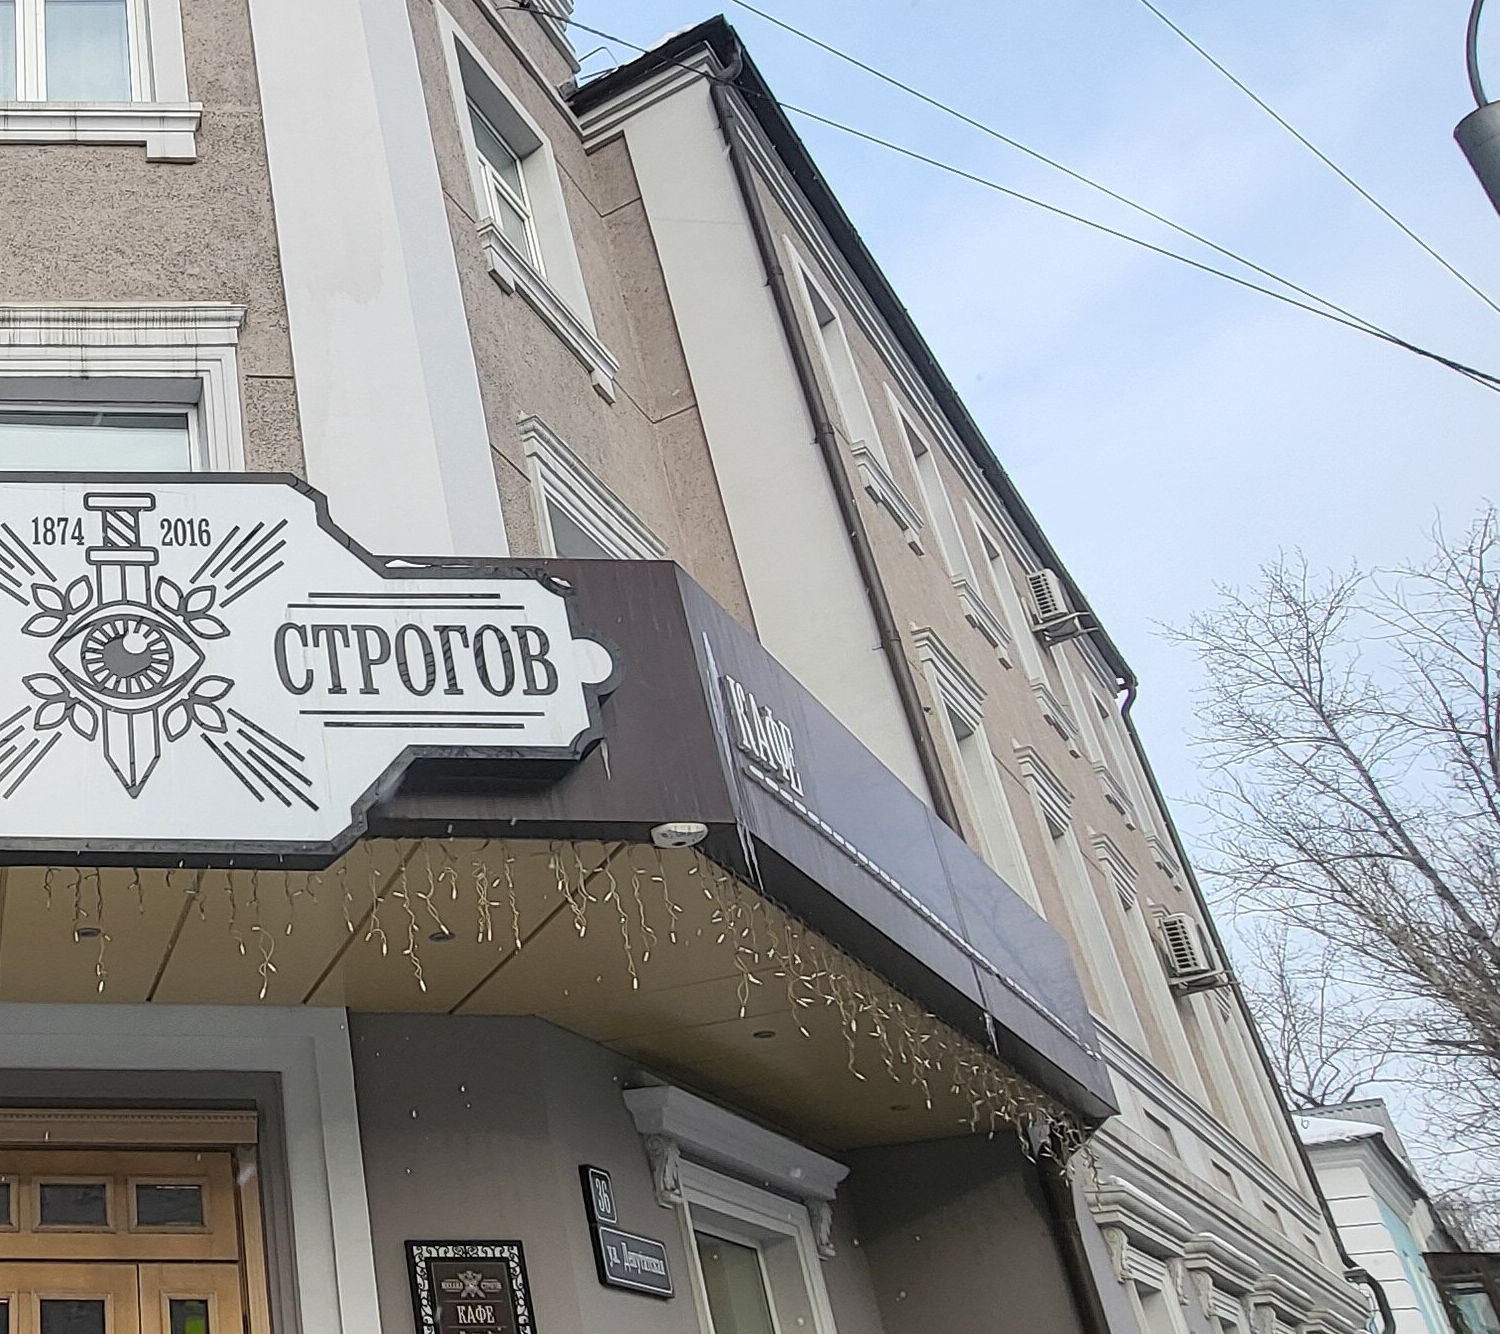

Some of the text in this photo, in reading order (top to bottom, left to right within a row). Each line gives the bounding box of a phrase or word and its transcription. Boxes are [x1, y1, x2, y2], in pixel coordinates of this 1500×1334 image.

[31, 516, 211, 546] 1874 2016
[274, 622, 569, 697] СТРОГОВ
[725, 675, 804, 797] КАФЕ
[595, 1178, 611, 1213] 36
[456, 1304, 496, 1324] КАФЕ
